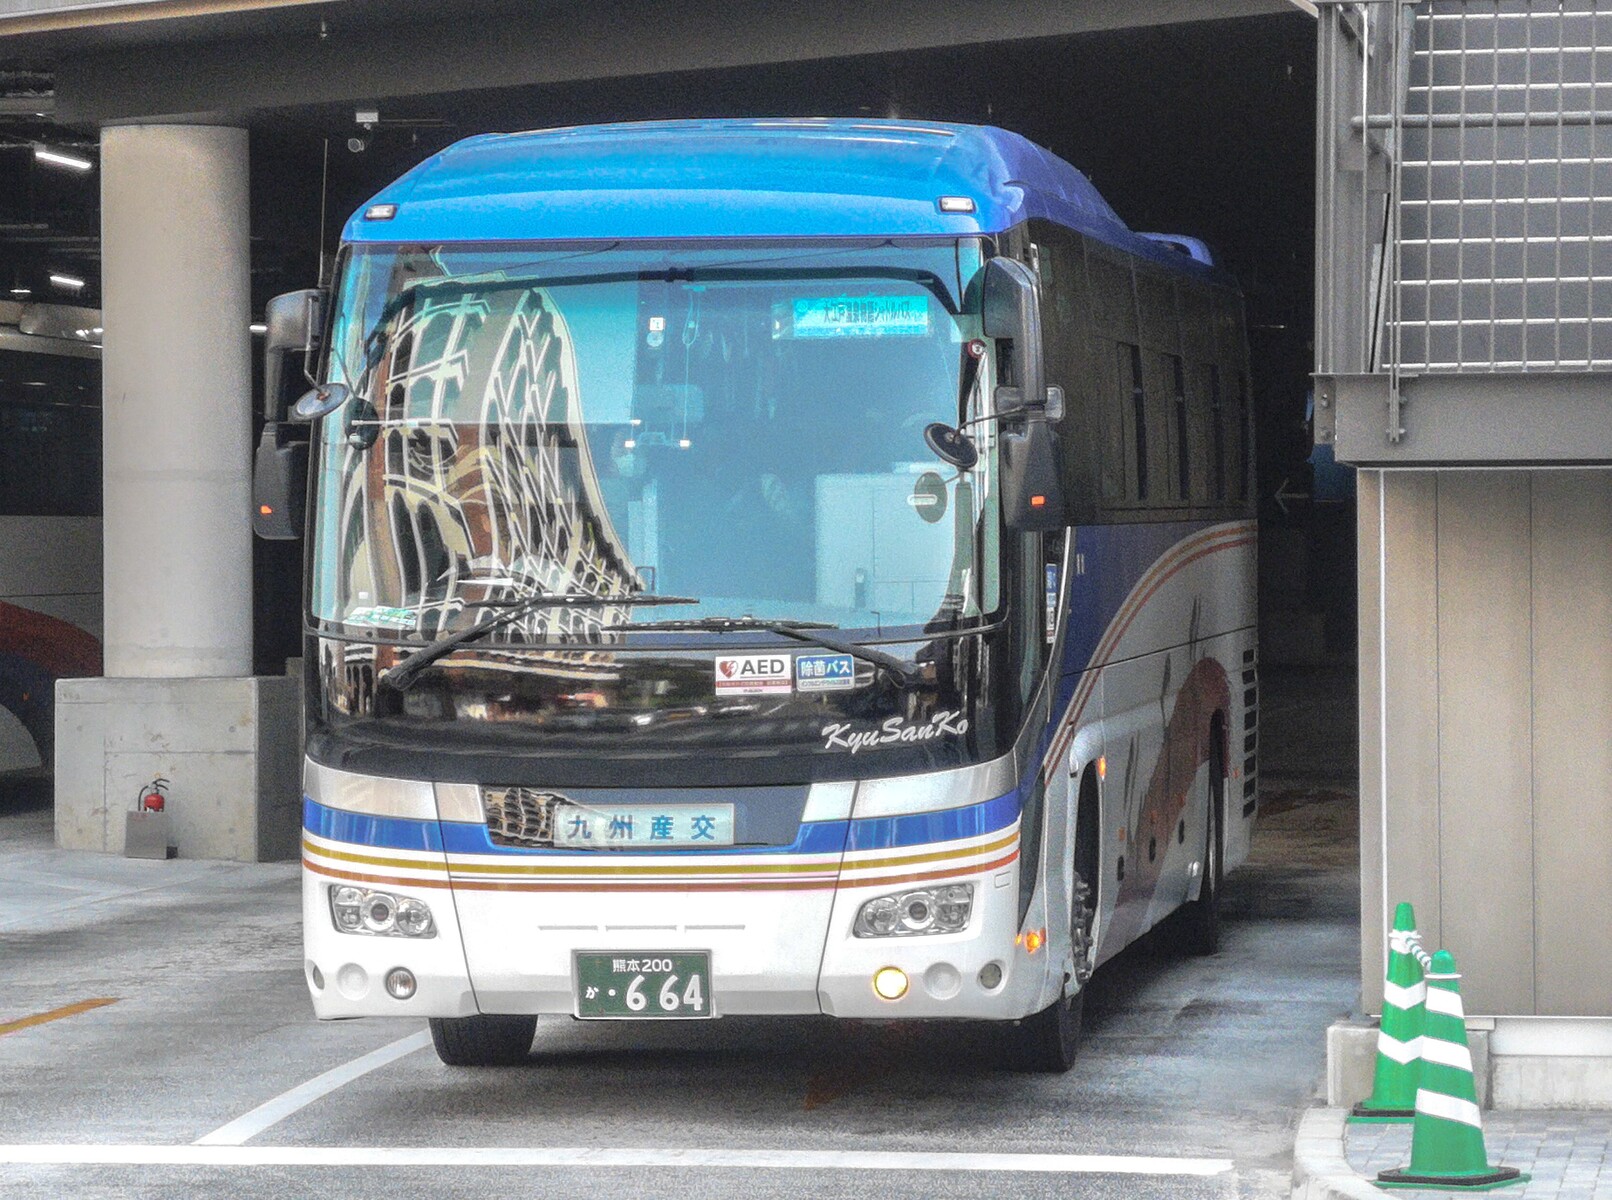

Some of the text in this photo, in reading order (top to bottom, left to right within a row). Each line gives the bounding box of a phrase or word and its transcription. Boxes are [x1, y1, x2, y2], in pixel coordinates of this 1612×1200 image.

[740, 659, 785, 675] AED
[801, 659, 850, 677] 除菌バス
[821, 711, 969, 754] KyuSanKo
[567, 815, 716, 841] 九州産交
[612, 959, 673, 972] 熊本200
